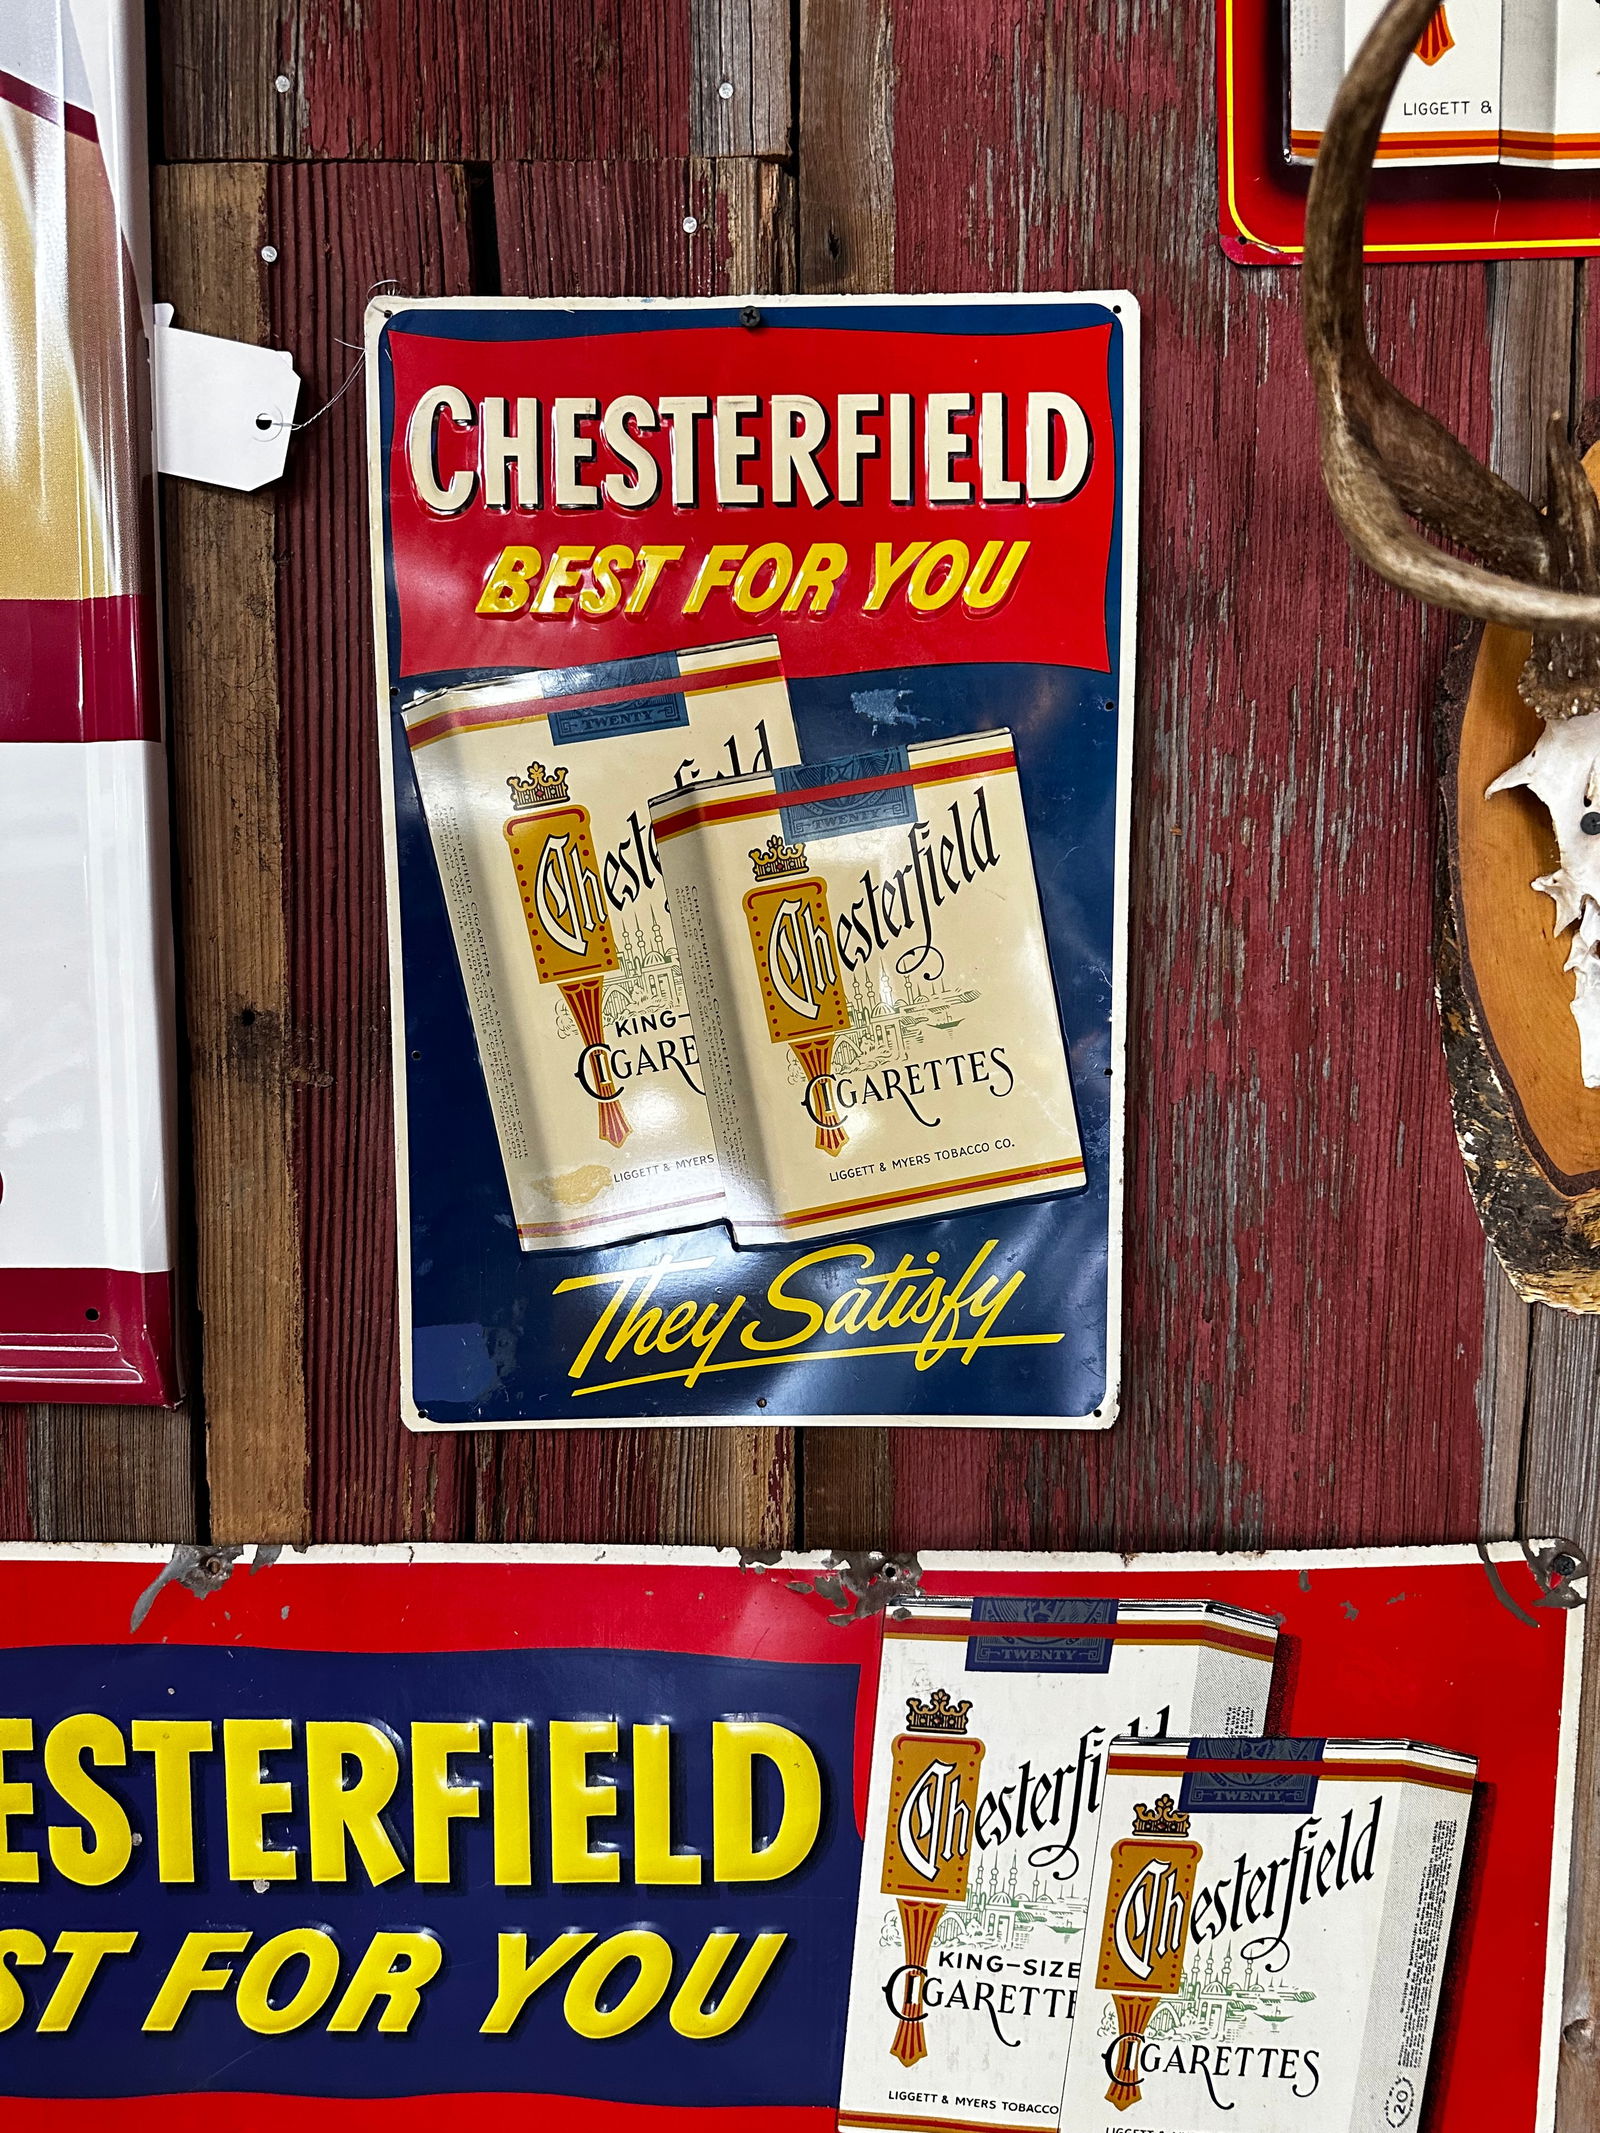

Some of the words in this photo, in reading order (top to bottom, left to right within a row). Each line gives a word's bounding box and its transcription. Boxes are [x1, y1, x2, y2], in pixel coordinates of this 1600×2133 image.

[1403, 100, 1470, 116] LIGGETT
[1480, 100, 1492, 114] &
[411, 384, 1093, 514] CHESTERFIELD
[475, 543, 682, 617] BEST
[682, 541, 849, 616] FOR
[861, 538, 1031, 613] YOU
[581, 709, 654, 730] TWENTY
[811, 808, 883, 831] TWENTY
[767, 785, 1001, 1021] Chesterfield
[800, 1047, 1014, 1128] CIGARETTES
[613, 1164, 660, 1184] LIGGETT
[663, 1162, 672, 1172] &
[675, 1153, 716, 1170] MYERS
[829, 1164, 876, 1183] LIGGETT
[879, 1162, 887, 1173] &
[892, 1153, 932, 1170] MYERS
[934, 1142, 990, 1162] TOBACCO
[994, 1138, 1016, 1151] CO.
[552, 1254, 745, 1389] They
[740, 1239, 1027, 1372] Satisfy
[1001, 1648, 1076, 1661] TWENTY
[1213, 1790, 1284, 1802] TWENTY
[1113, 1795, 1383, 1982] Chesterfield
[142, 1927, 442, 2036] FOR
[479, 1929, 788, 2040] YOU
[938, 1951, 1081, 1979] KING-SIZE
[1100, 2032, 1320, 2111] CIGARETTES
[888, 2090, 938, 2104] LIGGETT
[941, 2095, 949, 2104] &
[955, 2096, 997, 2110] MYERS
[1001, 2101, 1060, 2115] TOBACCO
